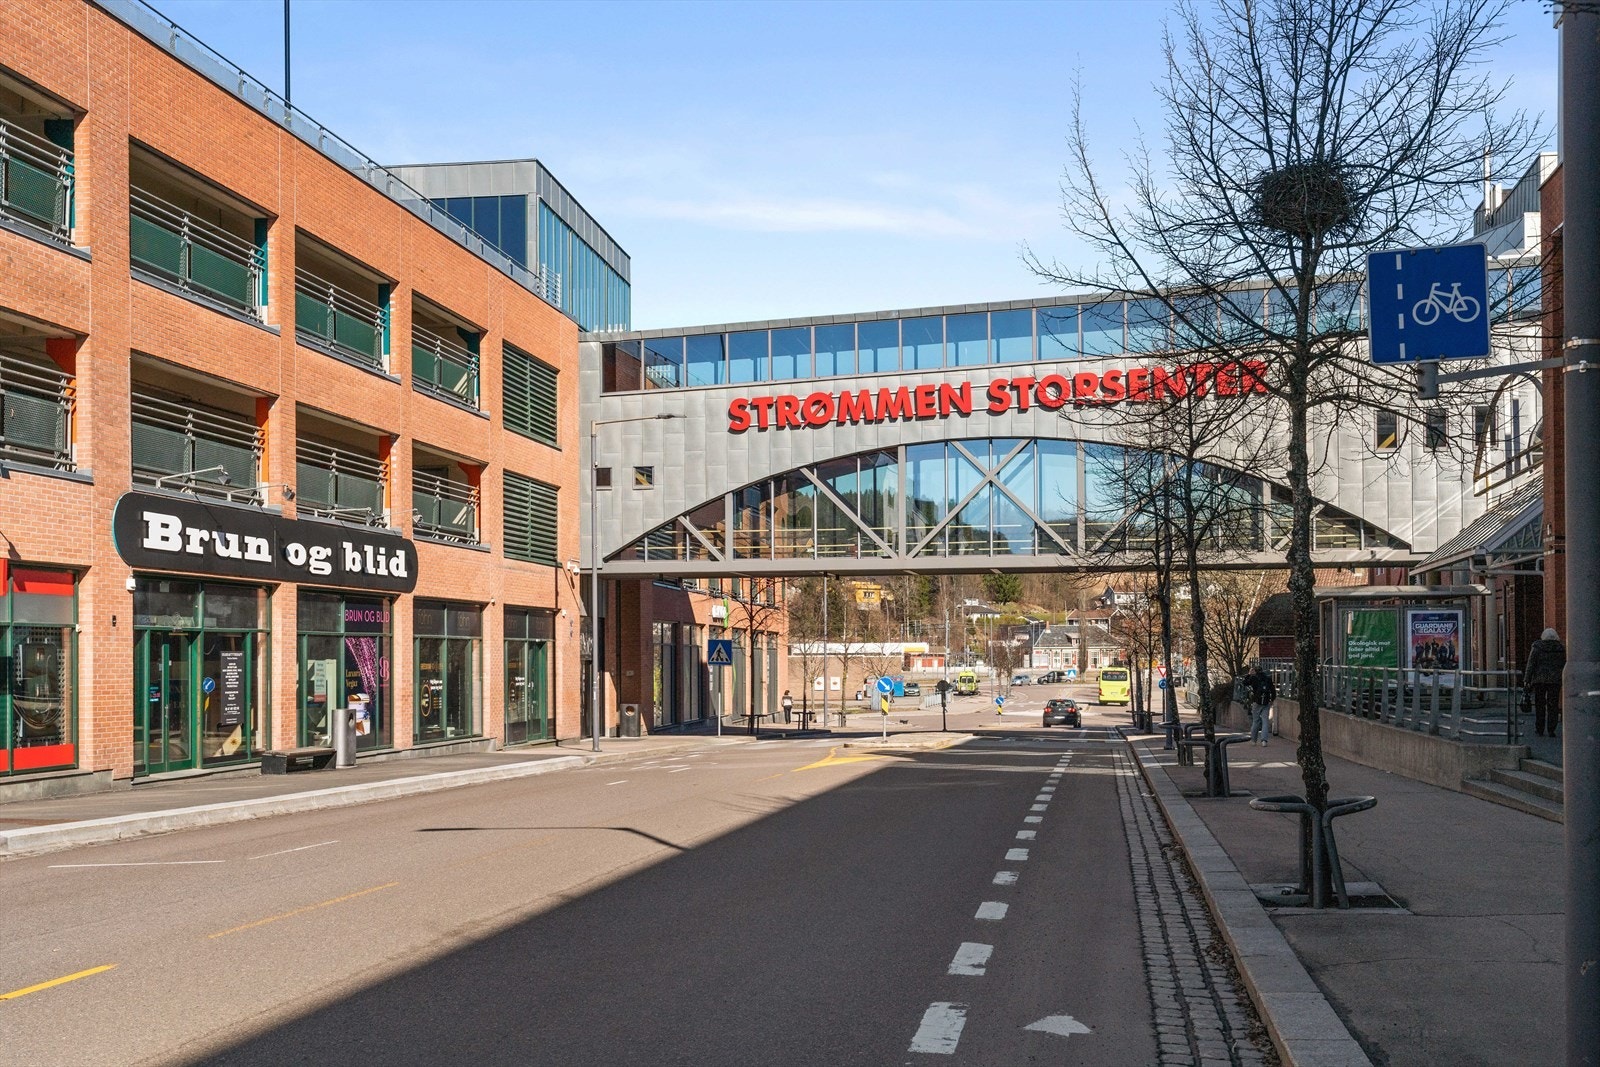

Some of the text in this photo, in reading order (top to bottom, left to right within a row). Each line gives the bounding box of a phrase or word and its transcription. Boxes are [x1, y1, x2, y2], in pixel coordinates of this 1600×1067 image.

[728, 360, 1268, 432] STRØMMEN STORSENTER
[143, 511, 408, 577] Brun og blid
[345, 609, 390, 623] BRUN OG BLID
